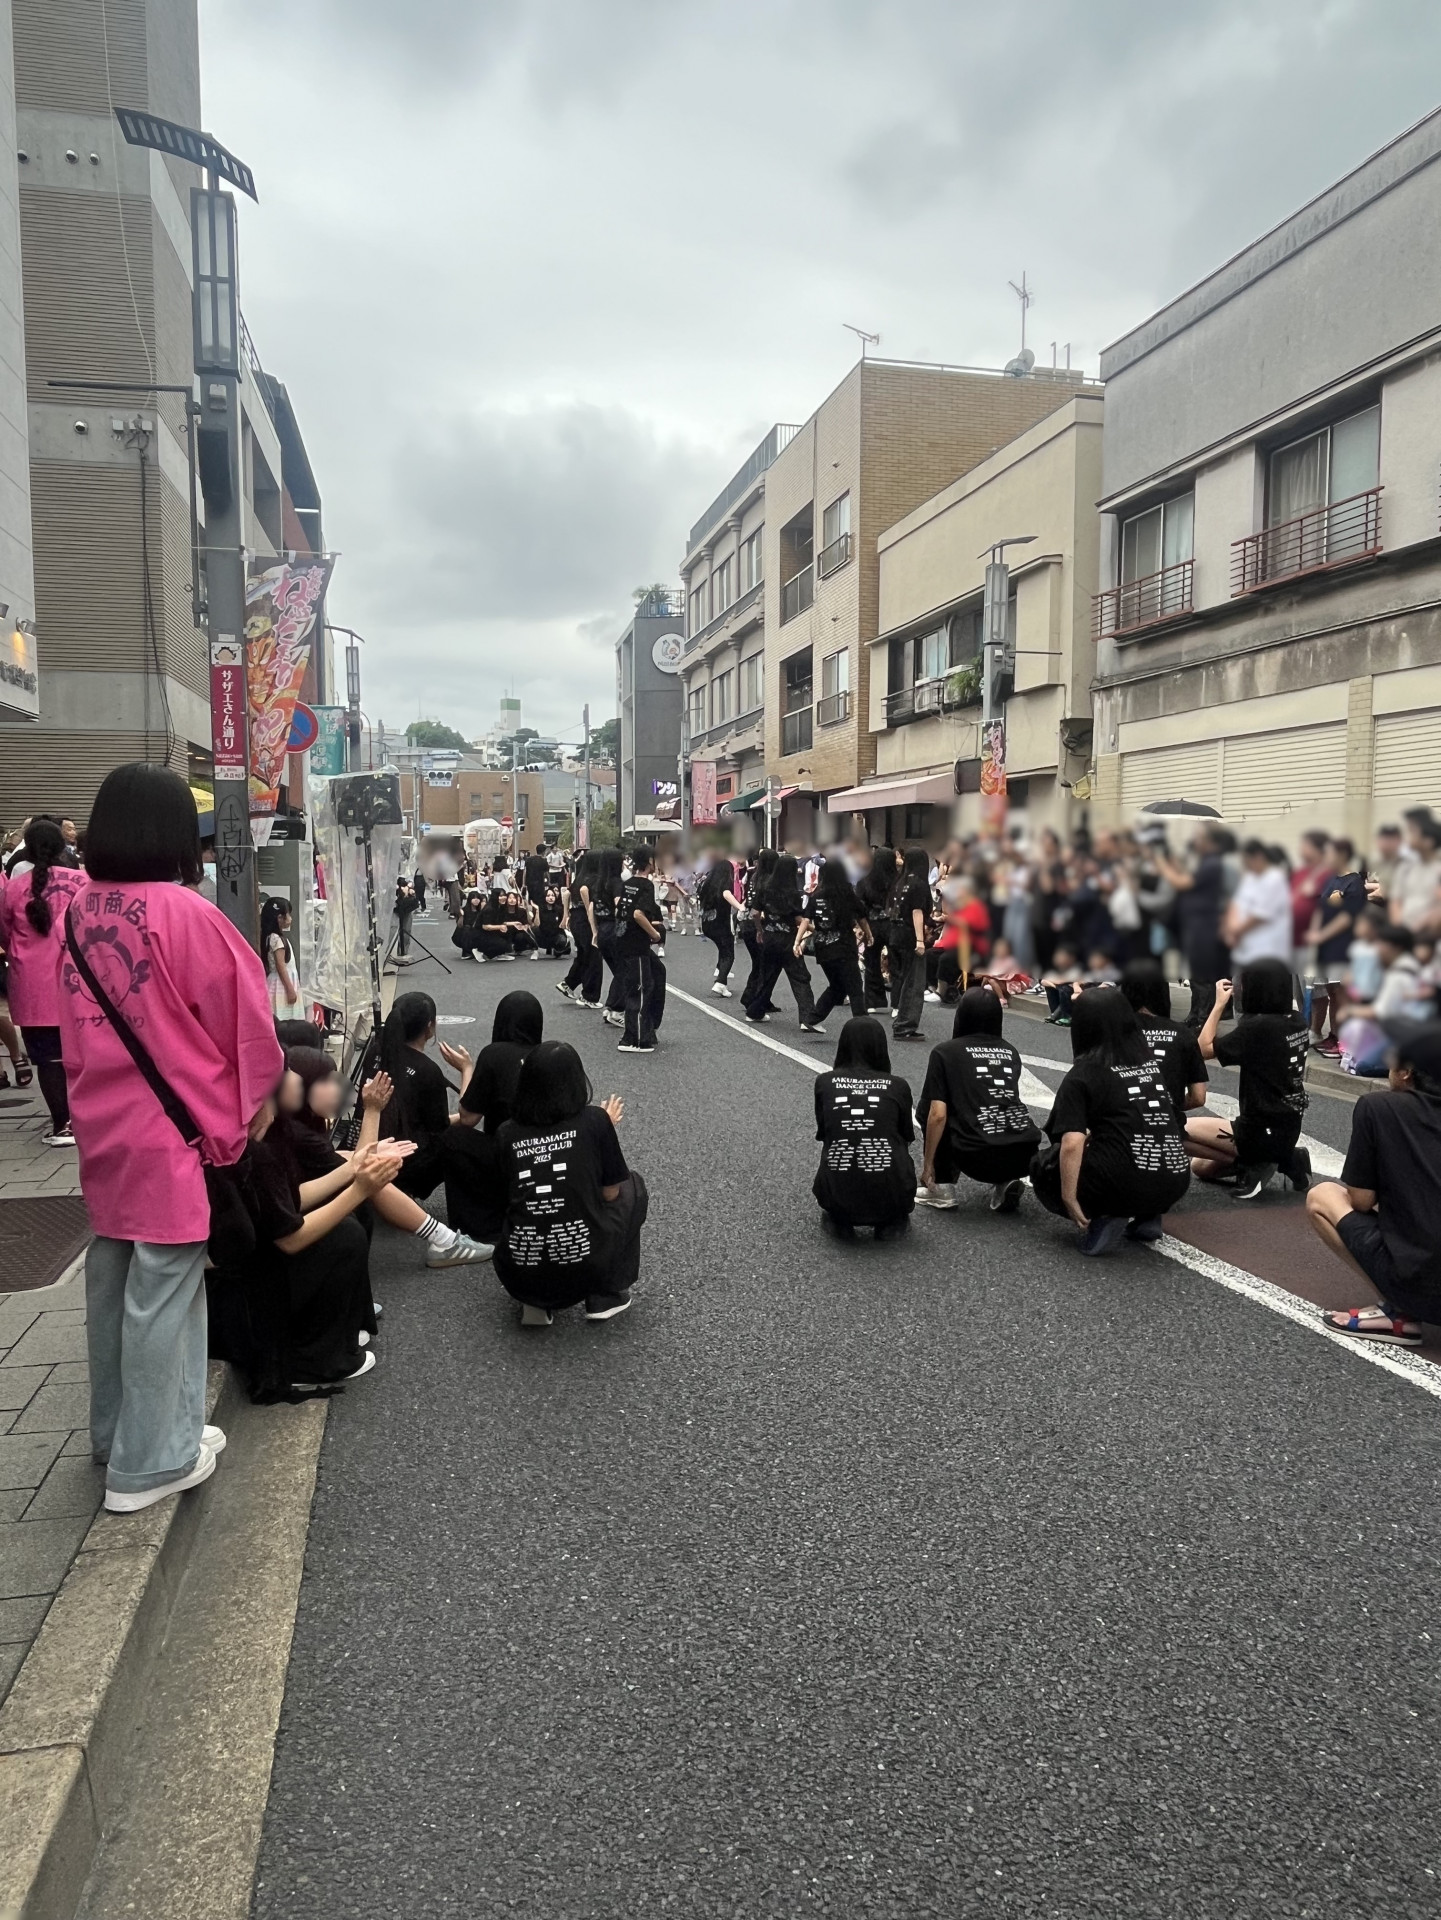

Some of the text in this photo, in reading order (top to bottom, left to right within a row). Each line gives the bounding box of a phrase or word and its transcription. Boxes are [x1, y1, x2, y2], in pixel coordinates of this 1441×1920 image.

[222, 670, 235, 749] サザエさん通り
[831, 1077, 892, 1085] SAKURAMACHI
[512, 1129, 577, 1150] SAKURAMACHI
[516, 1140, 573, 1158] DANCE CLUB
[533, 1153, 552, 1164] 2025
